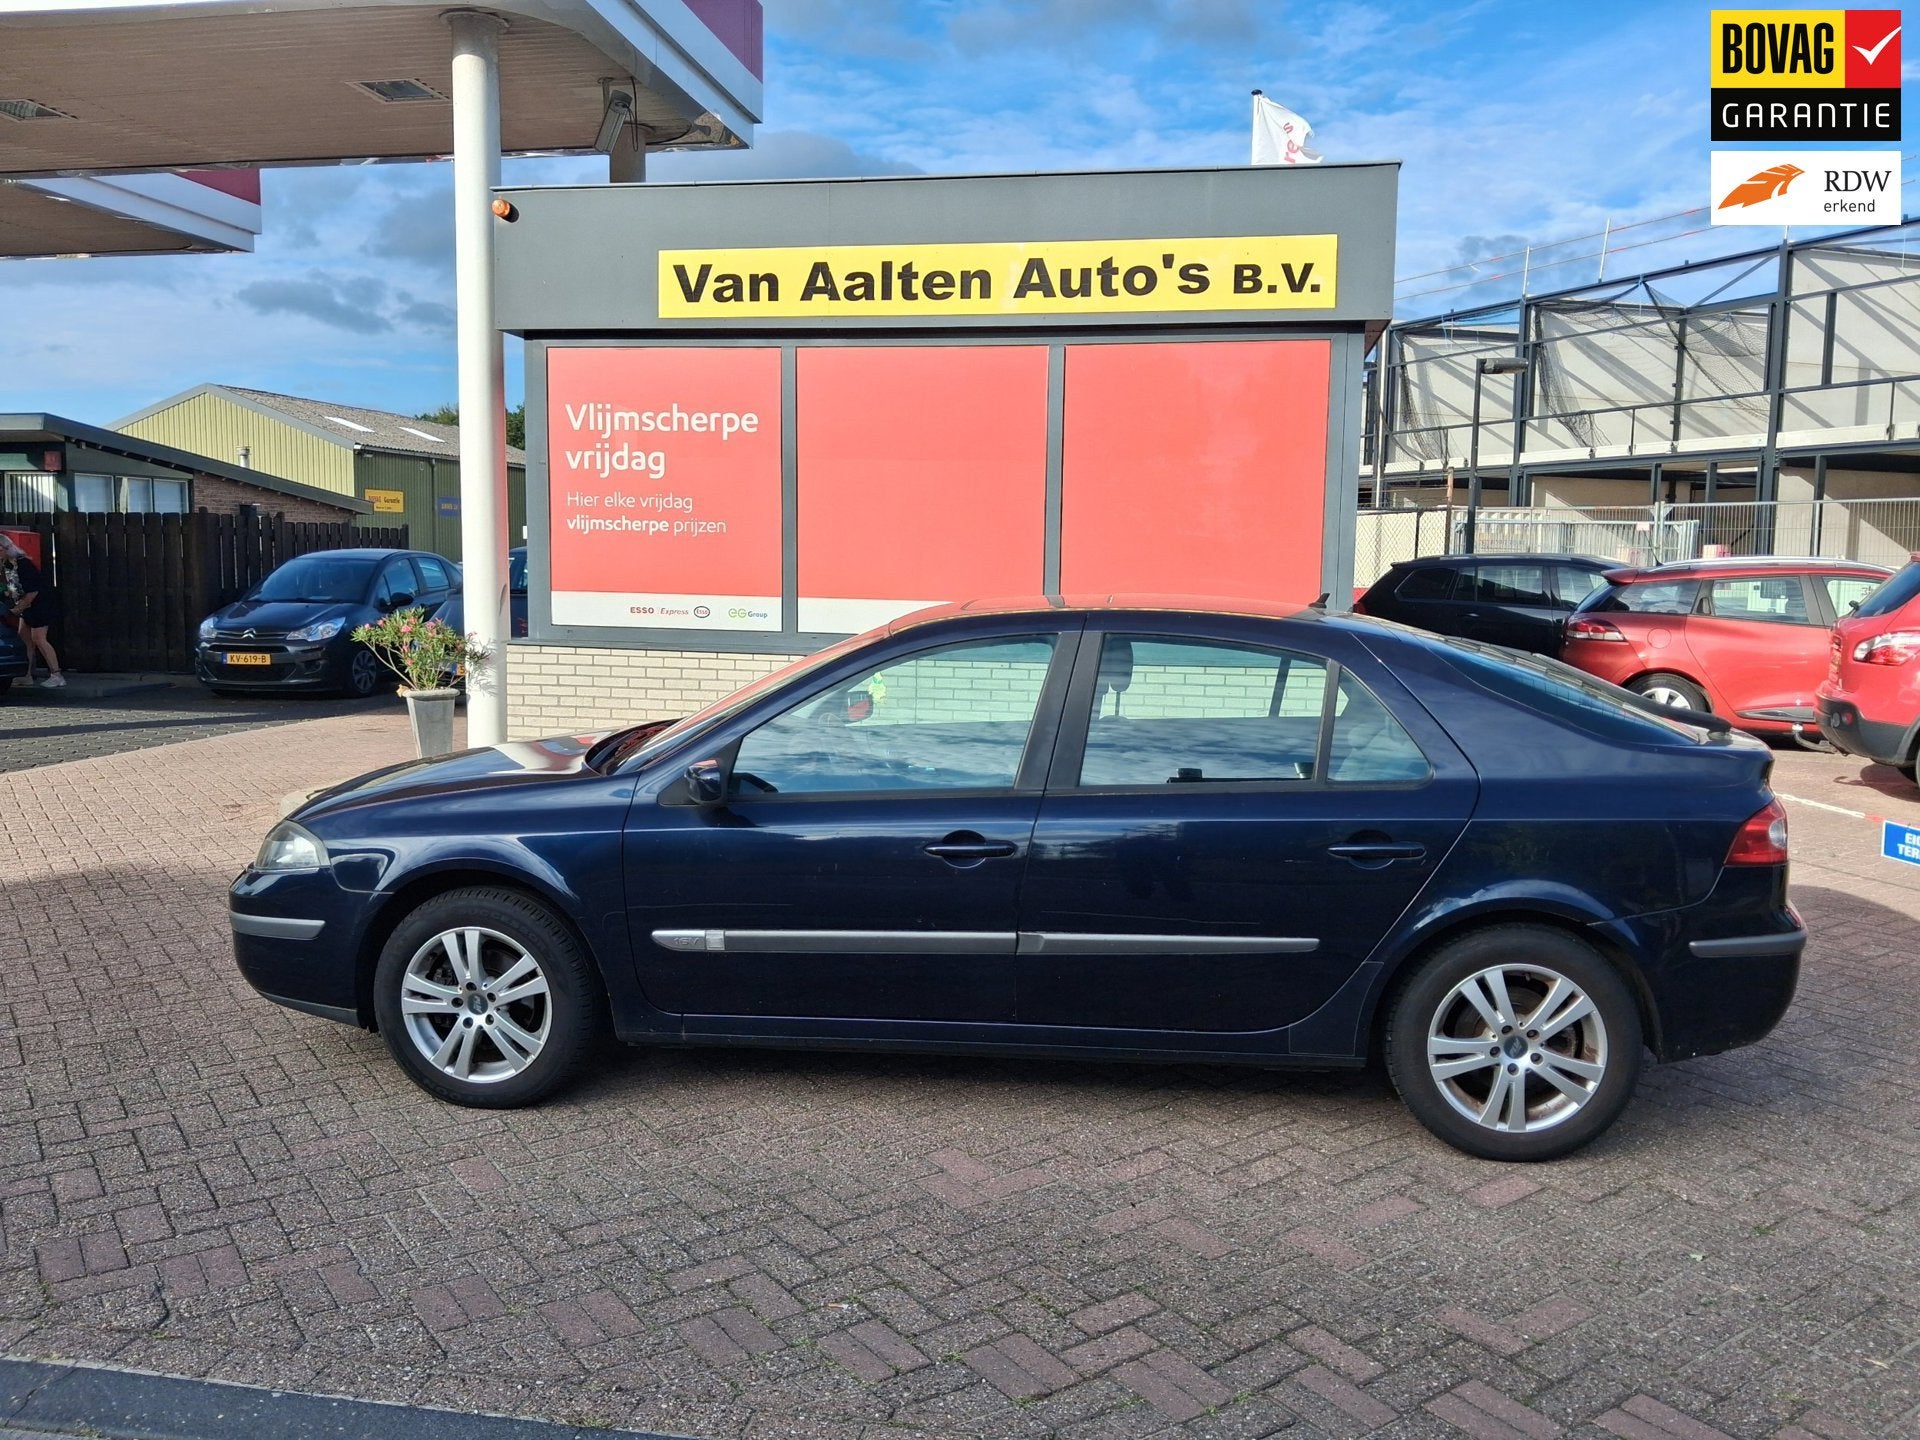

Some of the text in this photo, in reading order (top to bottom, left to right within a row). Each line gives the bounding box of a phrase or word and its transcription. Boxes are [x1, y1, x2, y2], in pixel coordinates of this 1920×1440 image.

[672, 253, 1321, 303] Van Aalten Auto's B.V.
[565, 402, 759, 441] Vlijmscherpe
[565, 442, 666, 479] vrijdag
[567, 491, 694, 513] Hier elke vrijdag
[566, 514, 727, 538] vlijmscherpe prijzen
[630, 606, 655, 614] ESSO
[660, 607, 689, 616] Express
[747, 610, 768, 619] Group
[230, 654, 267, 664] KV-619-B
[1905, 832, 1920, 847] EI
